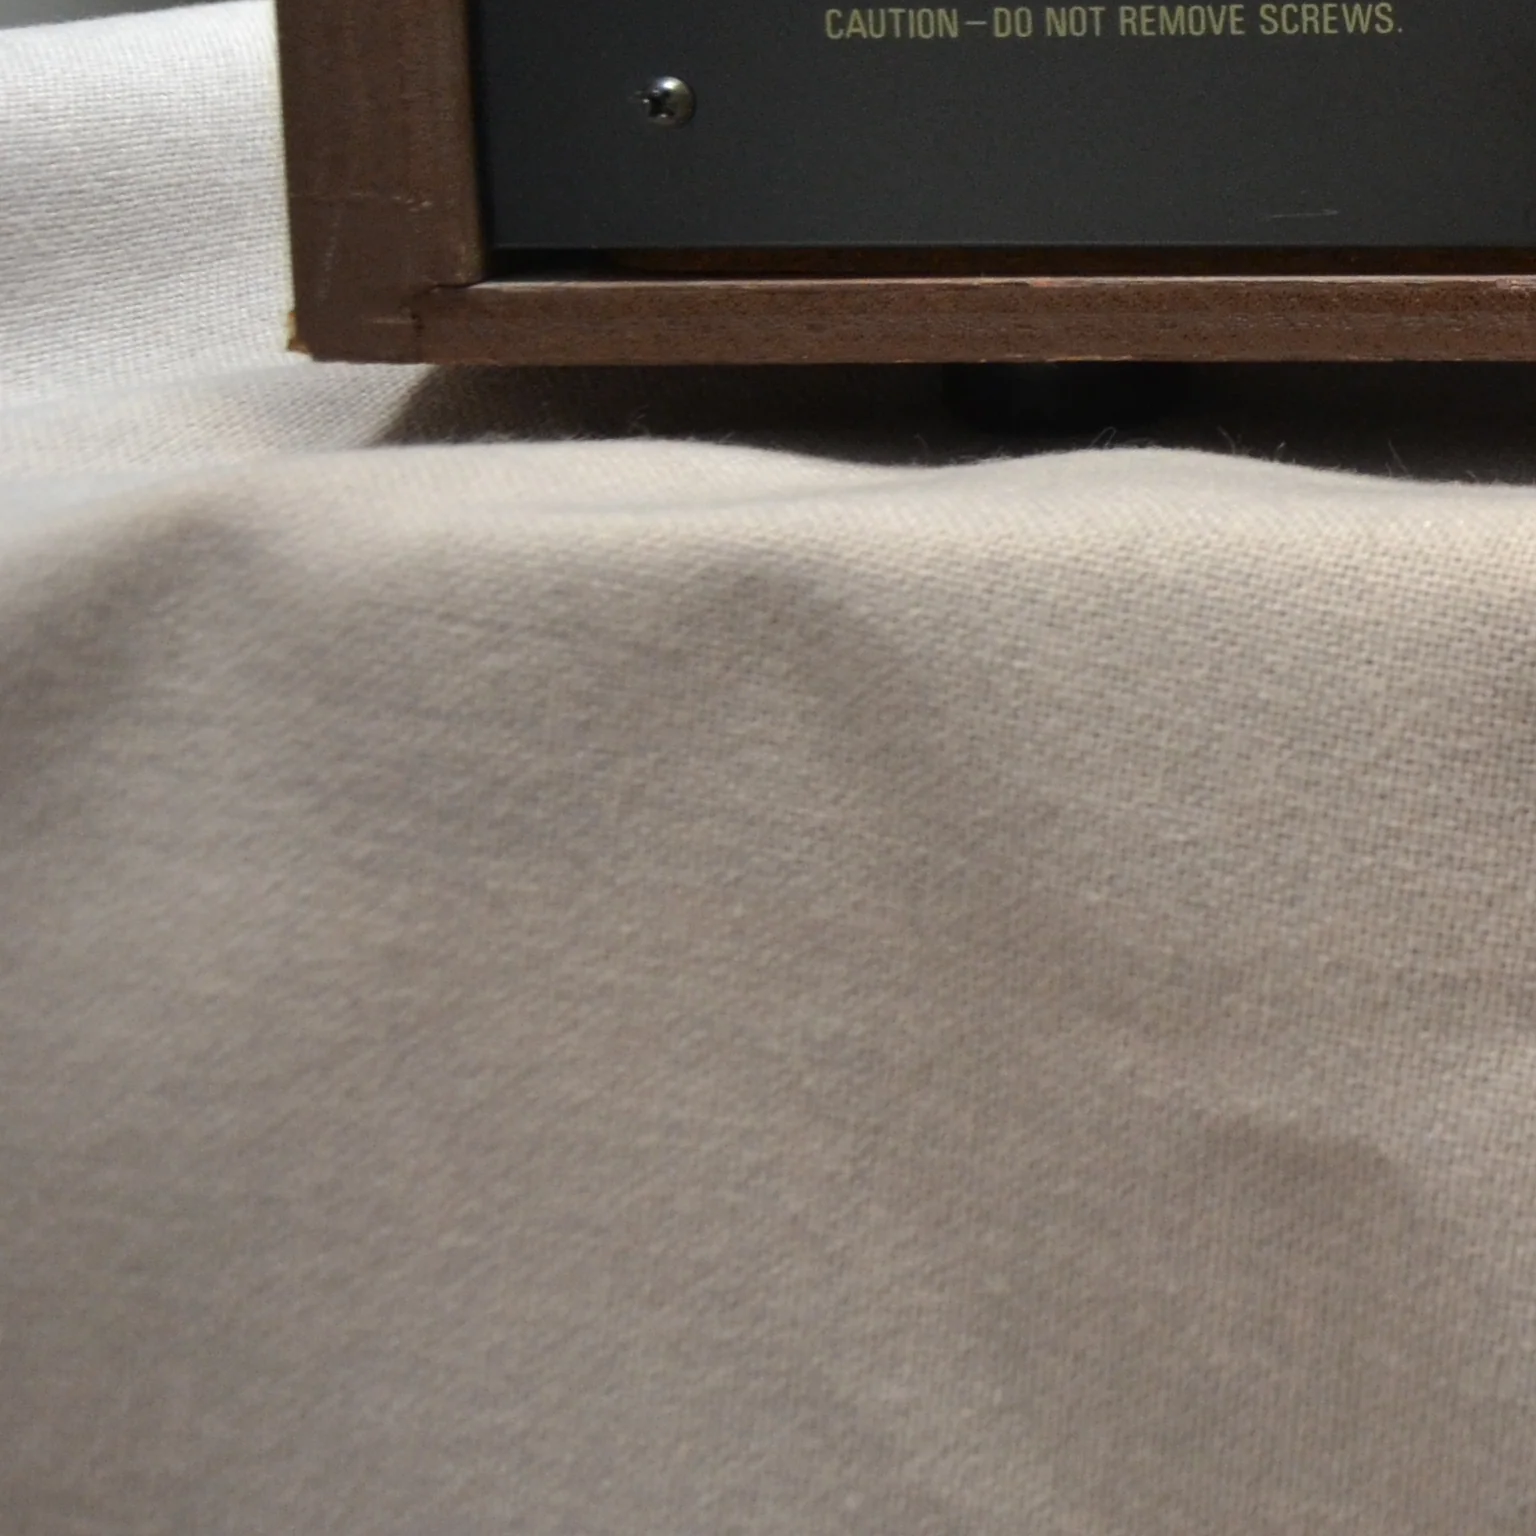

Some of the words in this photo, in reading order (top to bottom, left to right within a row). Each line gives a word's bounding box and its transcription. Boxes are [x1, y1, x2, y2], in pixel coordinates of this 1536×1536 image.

[1045, 5, 1106, 37] NOT
[1119, 4, 1246, 37] REMOVE
[1259, 2, 1404, 36] SCREWS.
